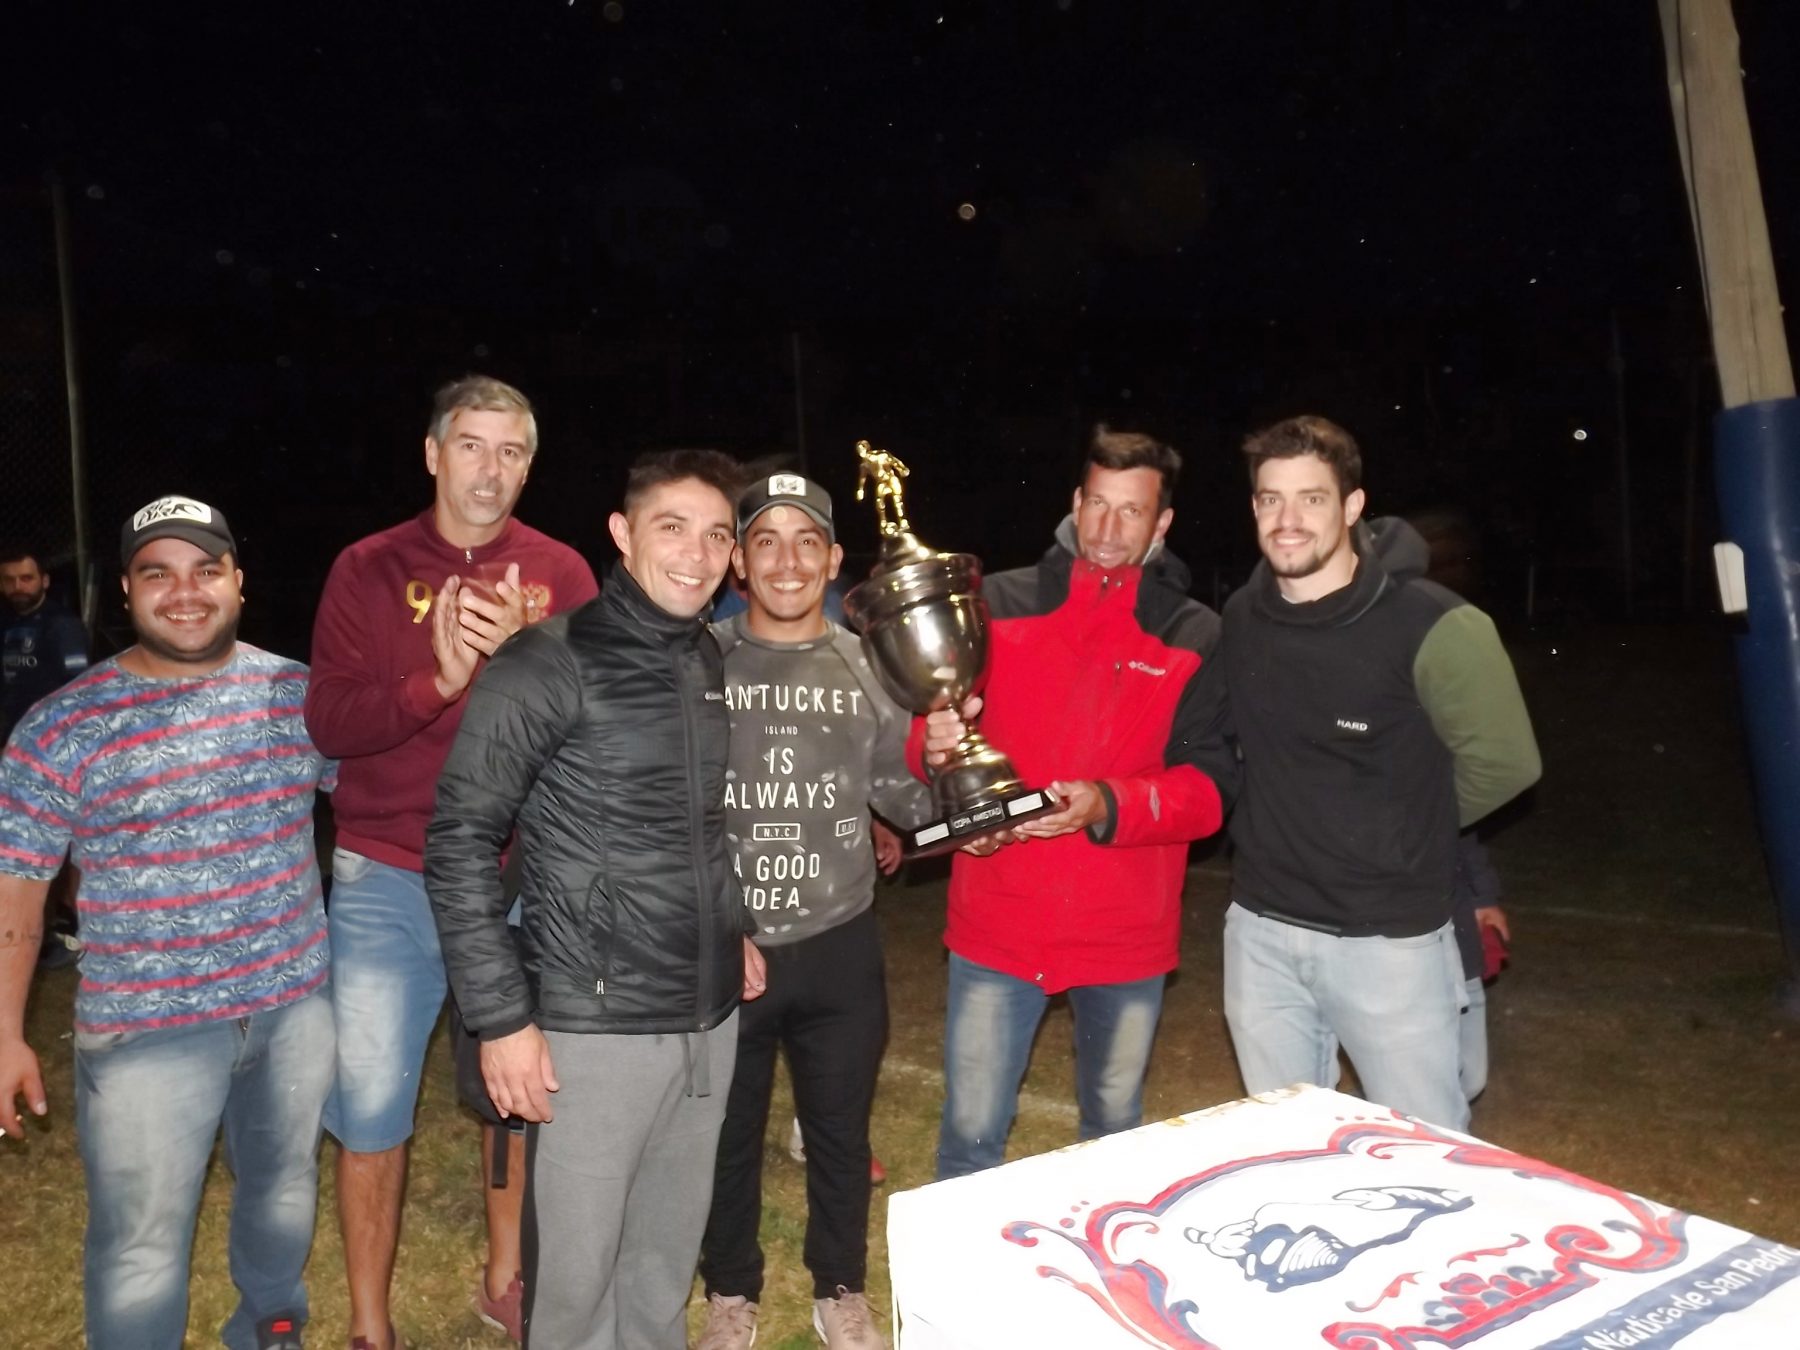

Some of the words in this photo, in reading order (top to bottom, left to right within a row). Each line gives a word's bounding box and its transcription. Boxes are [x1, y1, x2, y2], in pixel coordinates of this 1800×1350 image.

[406, 580, 432, 624] 9
[765, 725, 798, 736] ISLAND
[1337, 719, 1368, 732] HARD
[769, 747, 794, 775] IS
[724, 781, 836, 810] ALWAYS
[734, 852, 743, 878] A
[756, 853, 820, 882] GOOD
[1693, 1269, 1753, 1296] San
